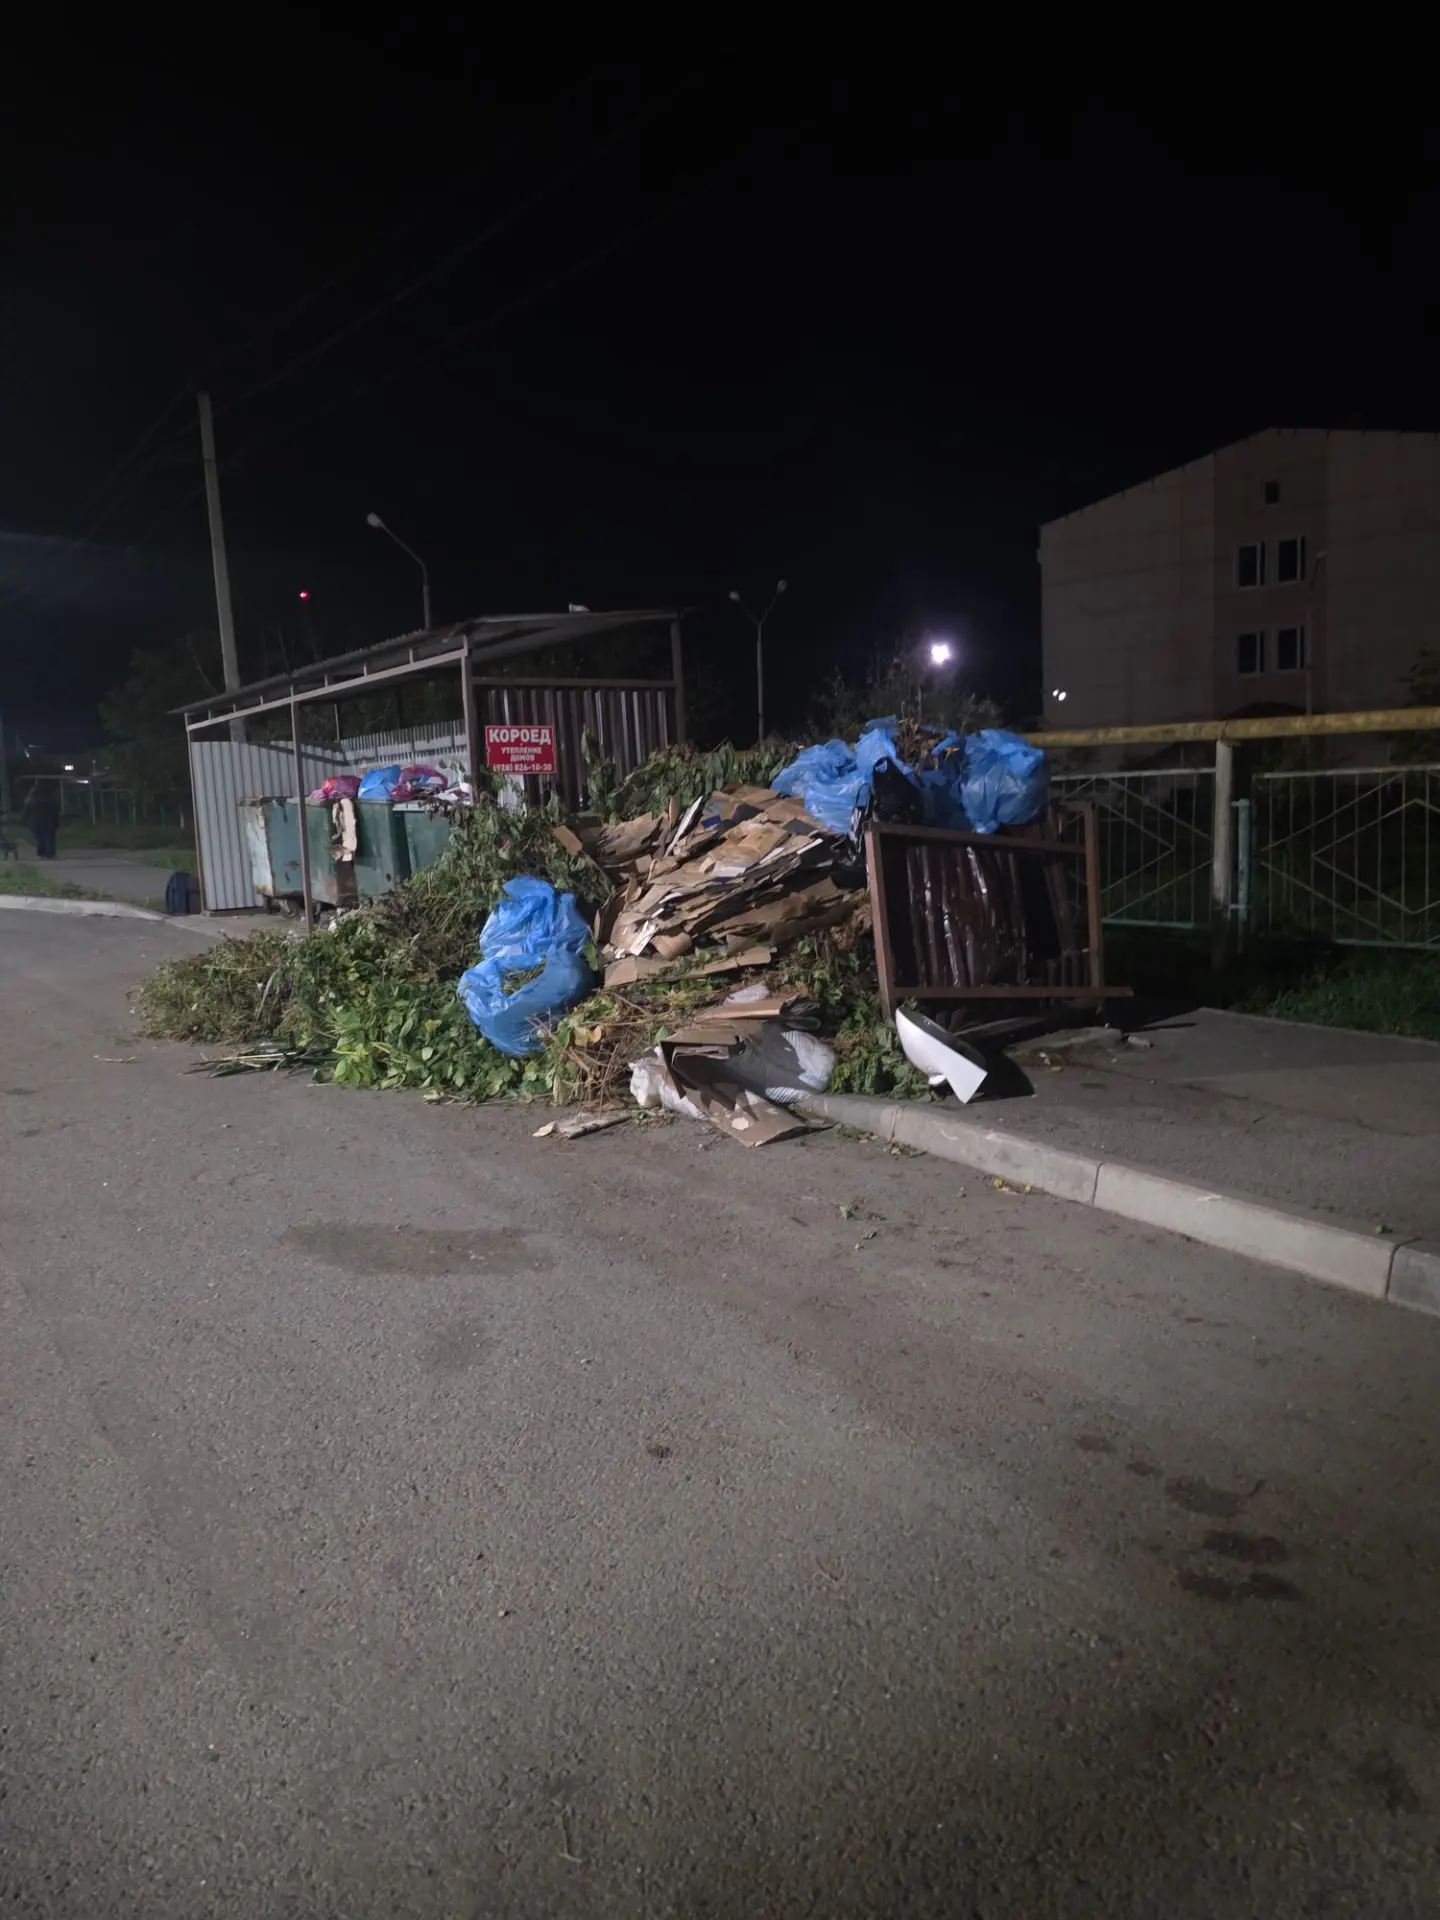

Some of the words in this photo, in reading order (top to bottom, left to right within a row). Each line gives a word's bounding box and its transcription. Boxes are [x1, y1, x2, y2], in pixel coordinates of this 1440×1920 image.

[489, 728, 551, 745] КОРОЕД
[501, 746, 542, 754] УТЕПЛЕНИЕ
[510, 754, 535, 762] ДОМОВ
